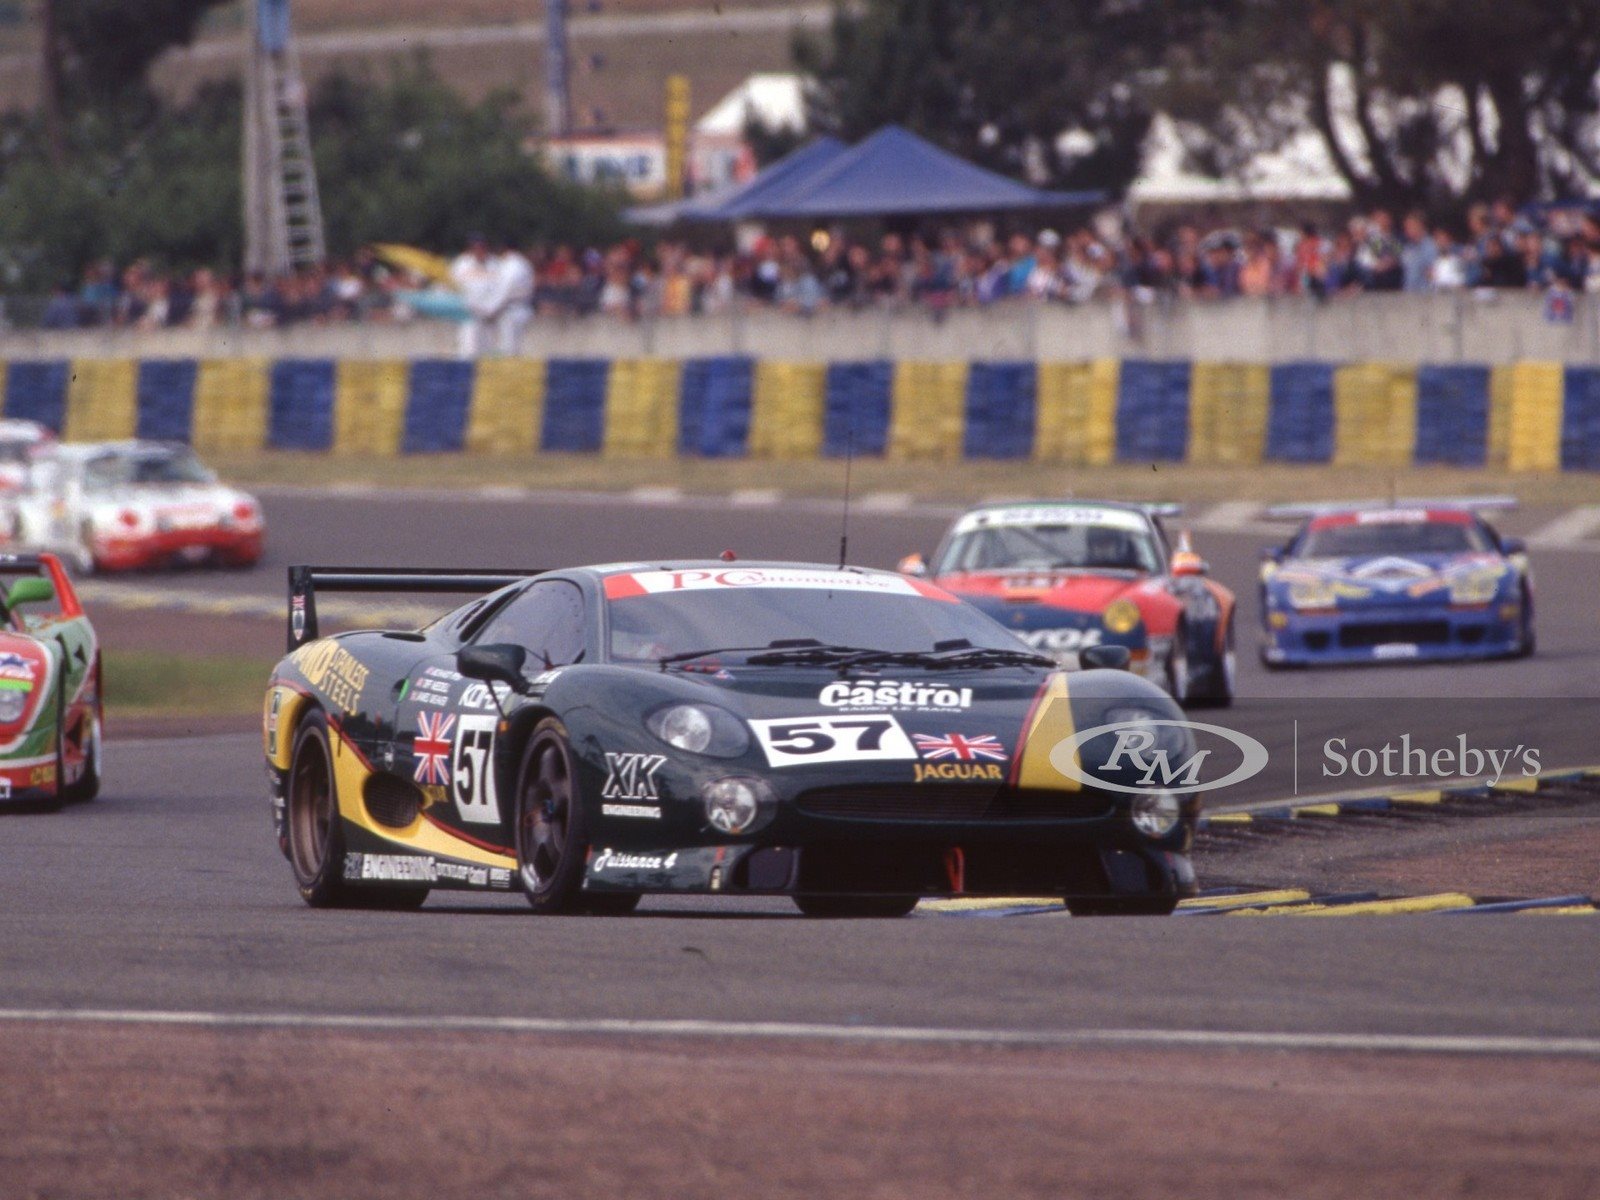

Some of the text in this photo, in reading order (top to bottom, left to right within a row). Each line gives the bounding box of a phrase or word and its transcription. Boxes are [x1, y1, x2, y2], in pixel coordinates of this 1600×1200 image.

[319, 669, 361, 716] STEELS
[818, 680, 973, 708] Castrol
[768, 720, 893, 755] 57
[456, 729, 495, 805] 57
[601, 751, 667, 800] XK
[912, 763, 1003, 783] JAGUAR
[664, 852, 679, 870] 4
